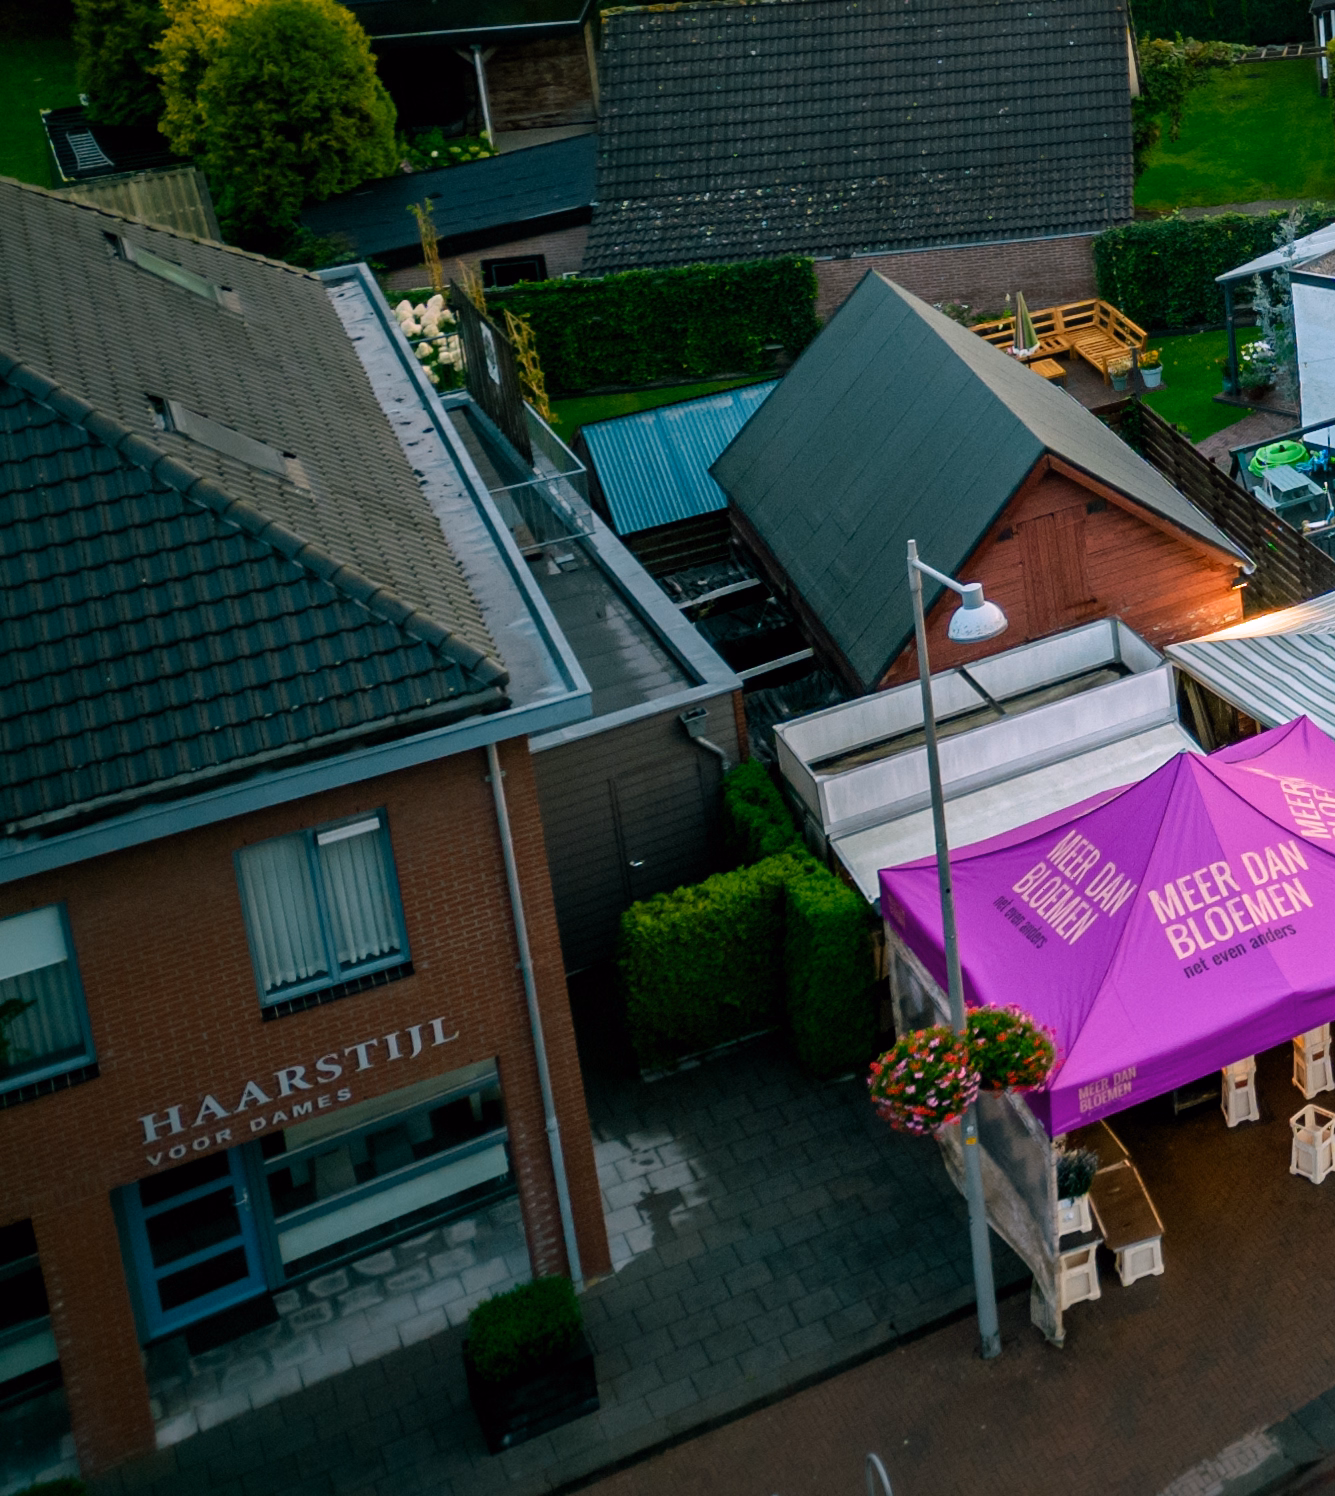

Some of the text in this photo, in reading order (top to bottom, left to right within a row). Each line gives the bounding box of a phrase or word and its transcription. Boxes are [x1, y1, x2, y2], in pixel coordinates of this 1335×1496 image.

[1280, 779, 1332, 839] MEER
[1012, 861, 1100, 946] BLOEMEN
[1046, 829, 1137, 918] MEER DAN
[1147, 839, 1309, 925] MEER DAN
[1164, 877, 1314, 961] BLOEMEN
[1183, 924, 1297, 979] net even anders
[138, 1016, 460, 1145] HAARSTIJL
[1078, 1065, 1137, 1101] MEER DAN
[1079, 1080, 1133, 1114] BLOEMEN
[146, 1088, 352, 1167] VOOR DAMES
